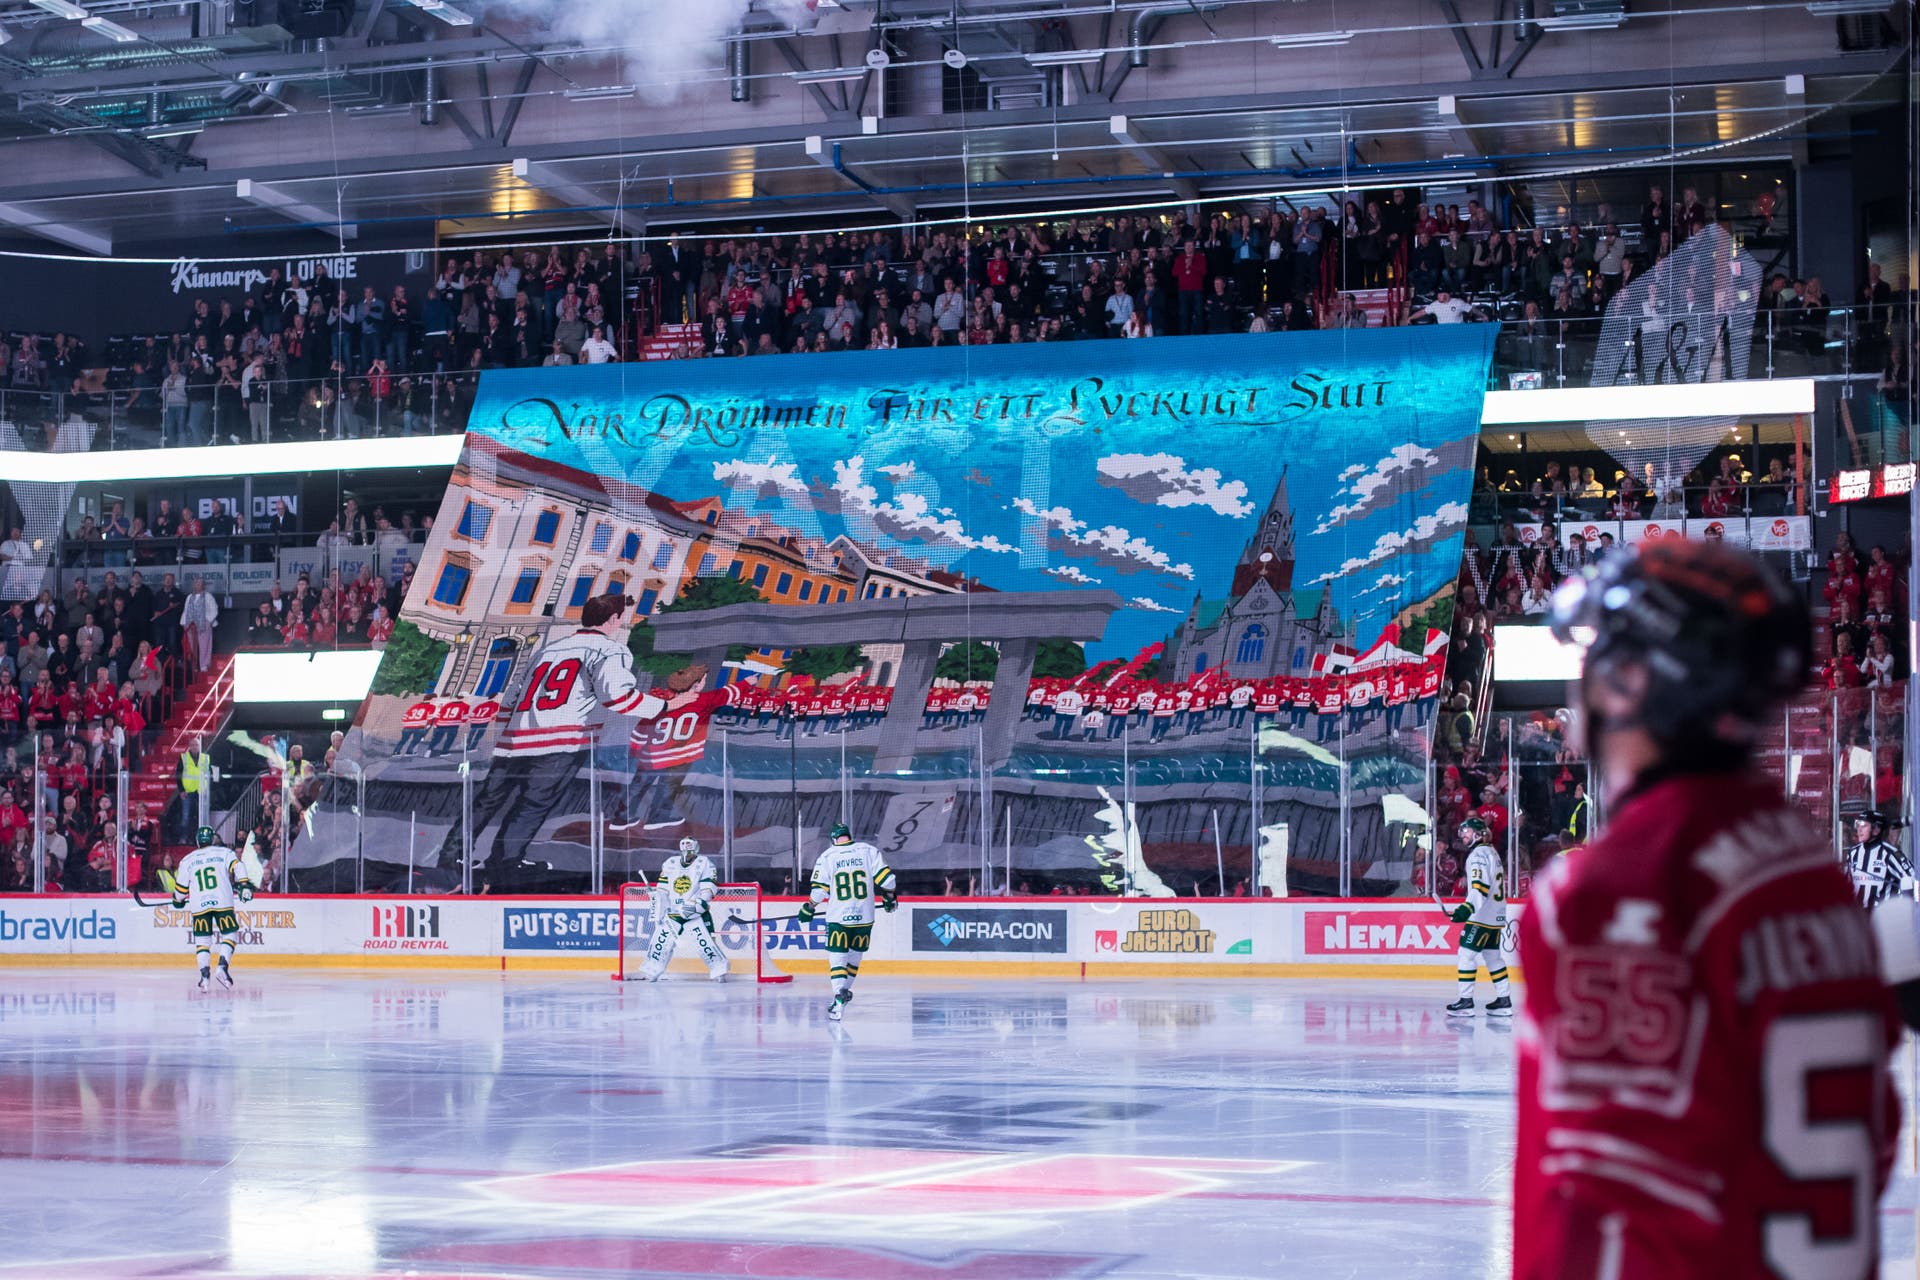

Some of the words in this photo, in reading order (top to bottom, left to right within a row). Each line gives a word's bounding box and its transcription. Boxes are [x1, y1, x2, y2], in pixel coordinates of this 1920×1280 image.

[171, 256, 271, 293] Kinnarps
[288, 560, 314, 574] itsy
[516, 658, 582, 712] 19
[1296, 691, 1311, 701] 42
[442, 706, 460, 719] 19
[476, 706, 490, 718] 17
[831, 699, 842, 708] 15
[1115, 697, 1130, 708] 37
[652, 712, 699, 745] 90
[194, 866, 217, 892] 16
[834, 869, 868, 901] 86
[0, 909, 116, 940] bravida
[945, 922, 1053, 940] INFRA-CON
[1139, 909, 1191, 931] EURO
[1120, 930, 1211, 953] JACKPOT
[1324, 915, 1451, 949] NEMAX
[363, 940, 398, 949] ROAD
[401, 940, 449, 949] RENTAL
[652, 928, 670, 961] FLOCK
